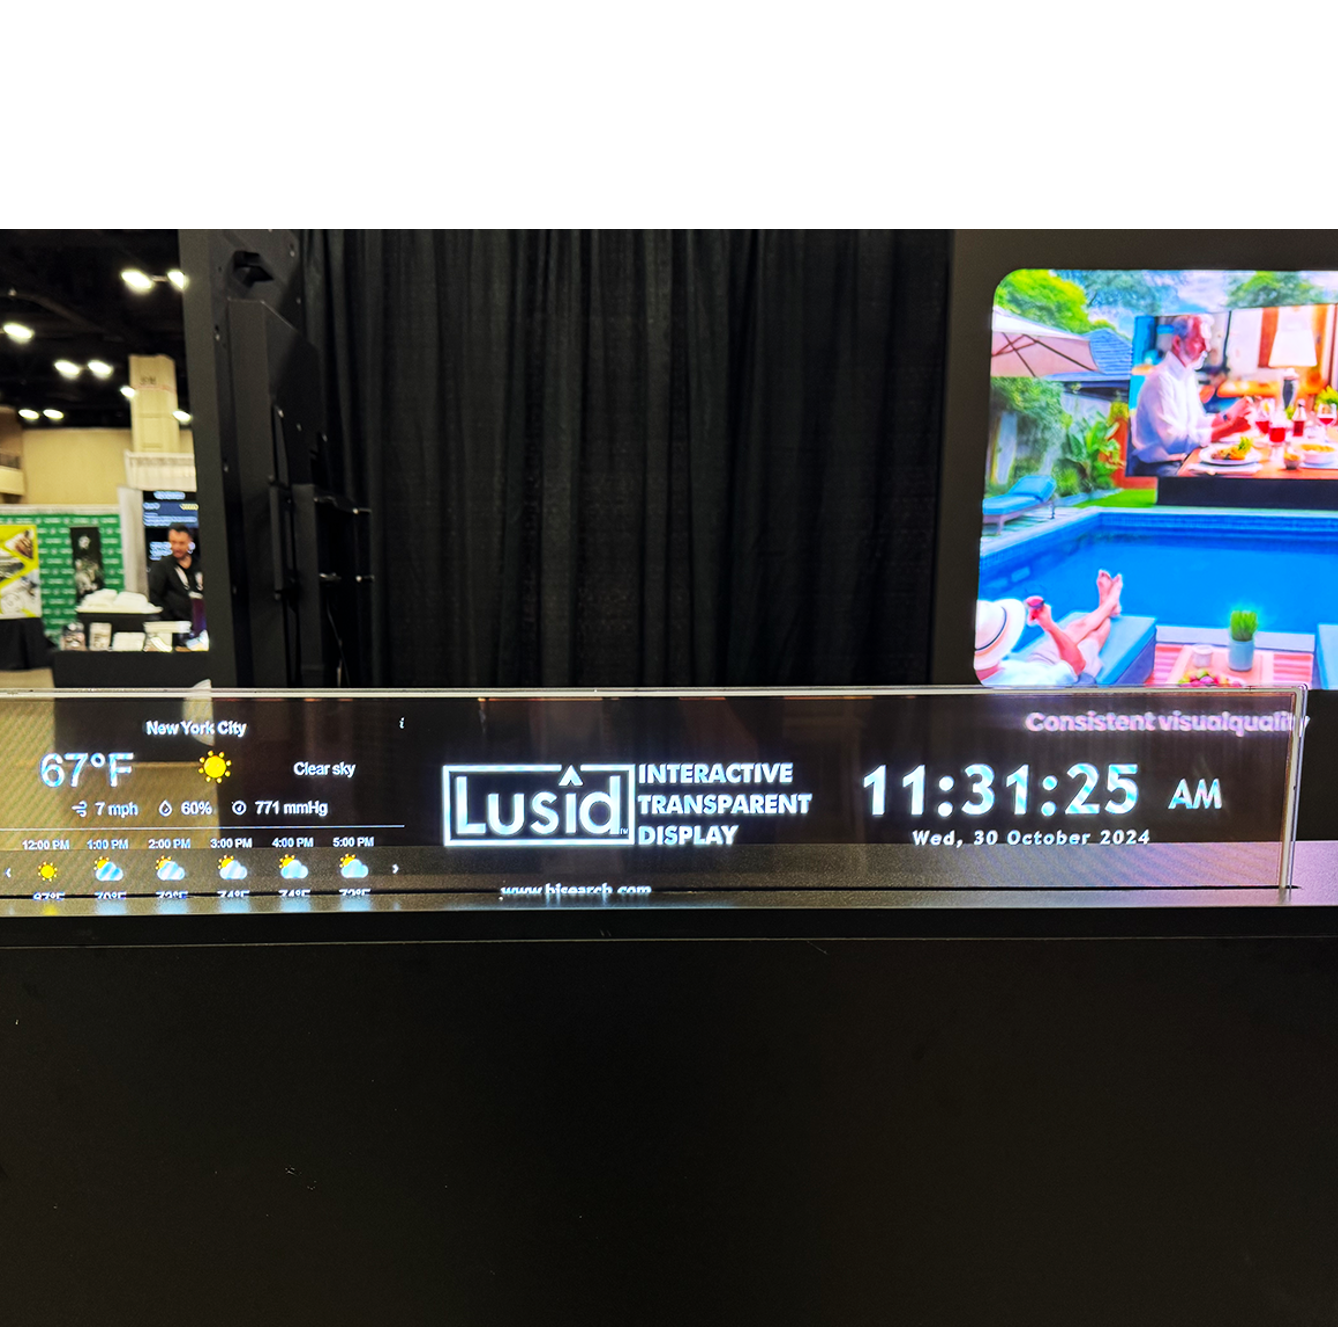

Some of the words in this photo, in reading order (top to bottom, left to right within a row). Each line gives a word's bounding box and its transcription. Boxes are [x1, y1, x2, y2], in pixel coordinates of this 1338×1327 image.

[145, 720, 179, 735] New
[180, 720, 215, 735] York
[216, 720, 248, 738] City
[1024, 710, 1156, 732] Consistent
[39, 752, 135, 788] 67°F
[293, 761, 331, 776] Clear
[332, 761, 356, 779] sky
[638, 762, 793, 784] INTERACTIVE
[862, 762, 1139, 818] 11:31:25
[1167, 778, 1223, 810] AM
[180, 800, 213, 816] 60%
[254, 800, 280, 815] 771
[283, 800, 329, 817] mmHg
[456, 764, 621, 836] Lusid
[637, 793, 813, 815] TRANSPARENT
[94, 801, 106, 816] 7
[107, 801, 139, 819] mph
[87, 838, 109, 850] 1:00
[111, 838, 129, 850] PM
[148, 838, 171, 849] 2:00
[173, 838, 191, 849] PM
[210, 837, 233, 849] 3:00
[235, 837, 253, 849] PM
[271, 837, 295, 848] 4:00
[296, 837, 314, 848] PM
[332, 836, 355, 848] 5:00
[357, 836, 375, 848] PM
[638, 824, 739, 846] DISPLAY
[911, 829, 964, 848] Wed,
[973, 829, 999, 846] 30
[1006, 829, 1091, 846] October
[1099, 829, 1151, 845] 2024
[22, 839, 50, 850] 12:00
[52, 839, 70, 850] PM
